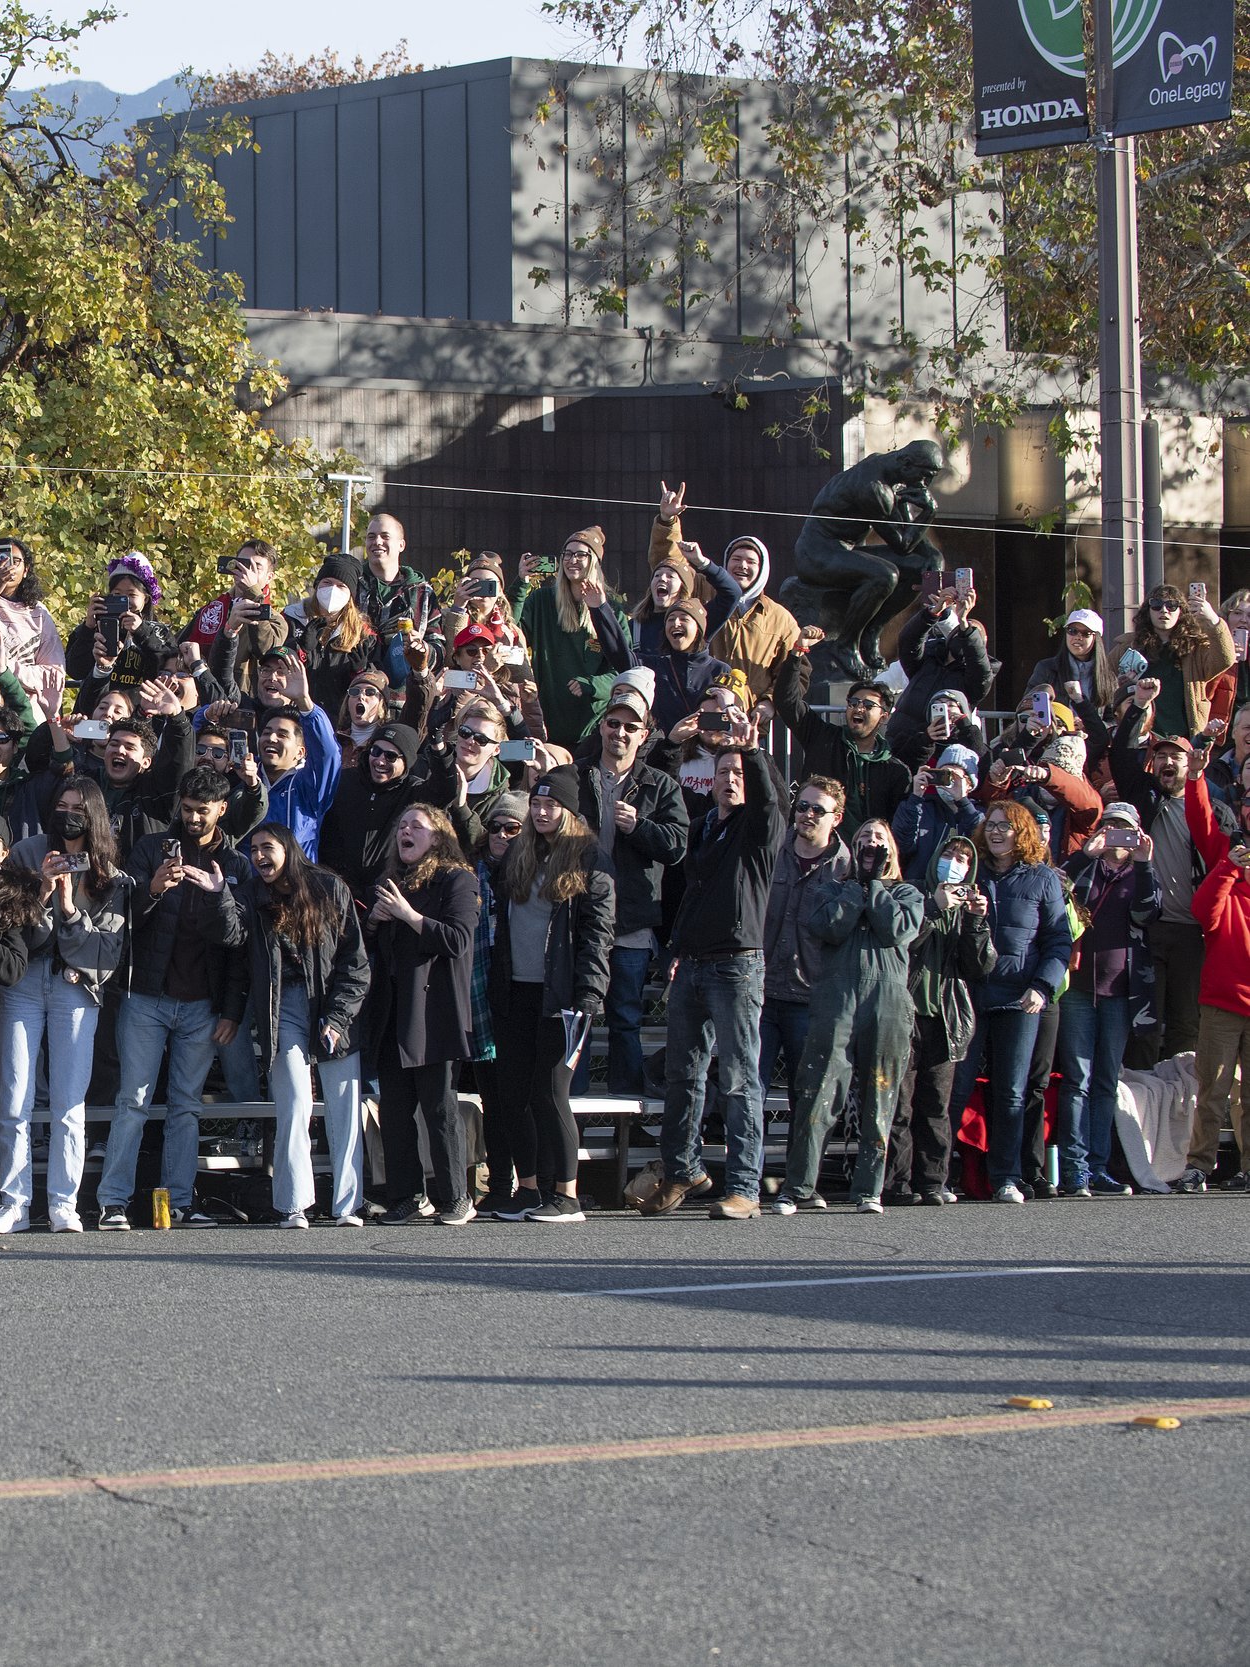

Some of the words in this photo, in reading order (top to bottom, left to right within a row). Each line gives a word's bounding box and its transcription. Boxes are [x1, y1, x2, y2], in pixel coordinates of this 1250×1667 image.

[981, 78, 1016, 98] presented
[1016, 76, 1027, 92] by
[1148, 80, 1227, 106] OneLegacy
[980, 97, 1084, 130] HONDA
